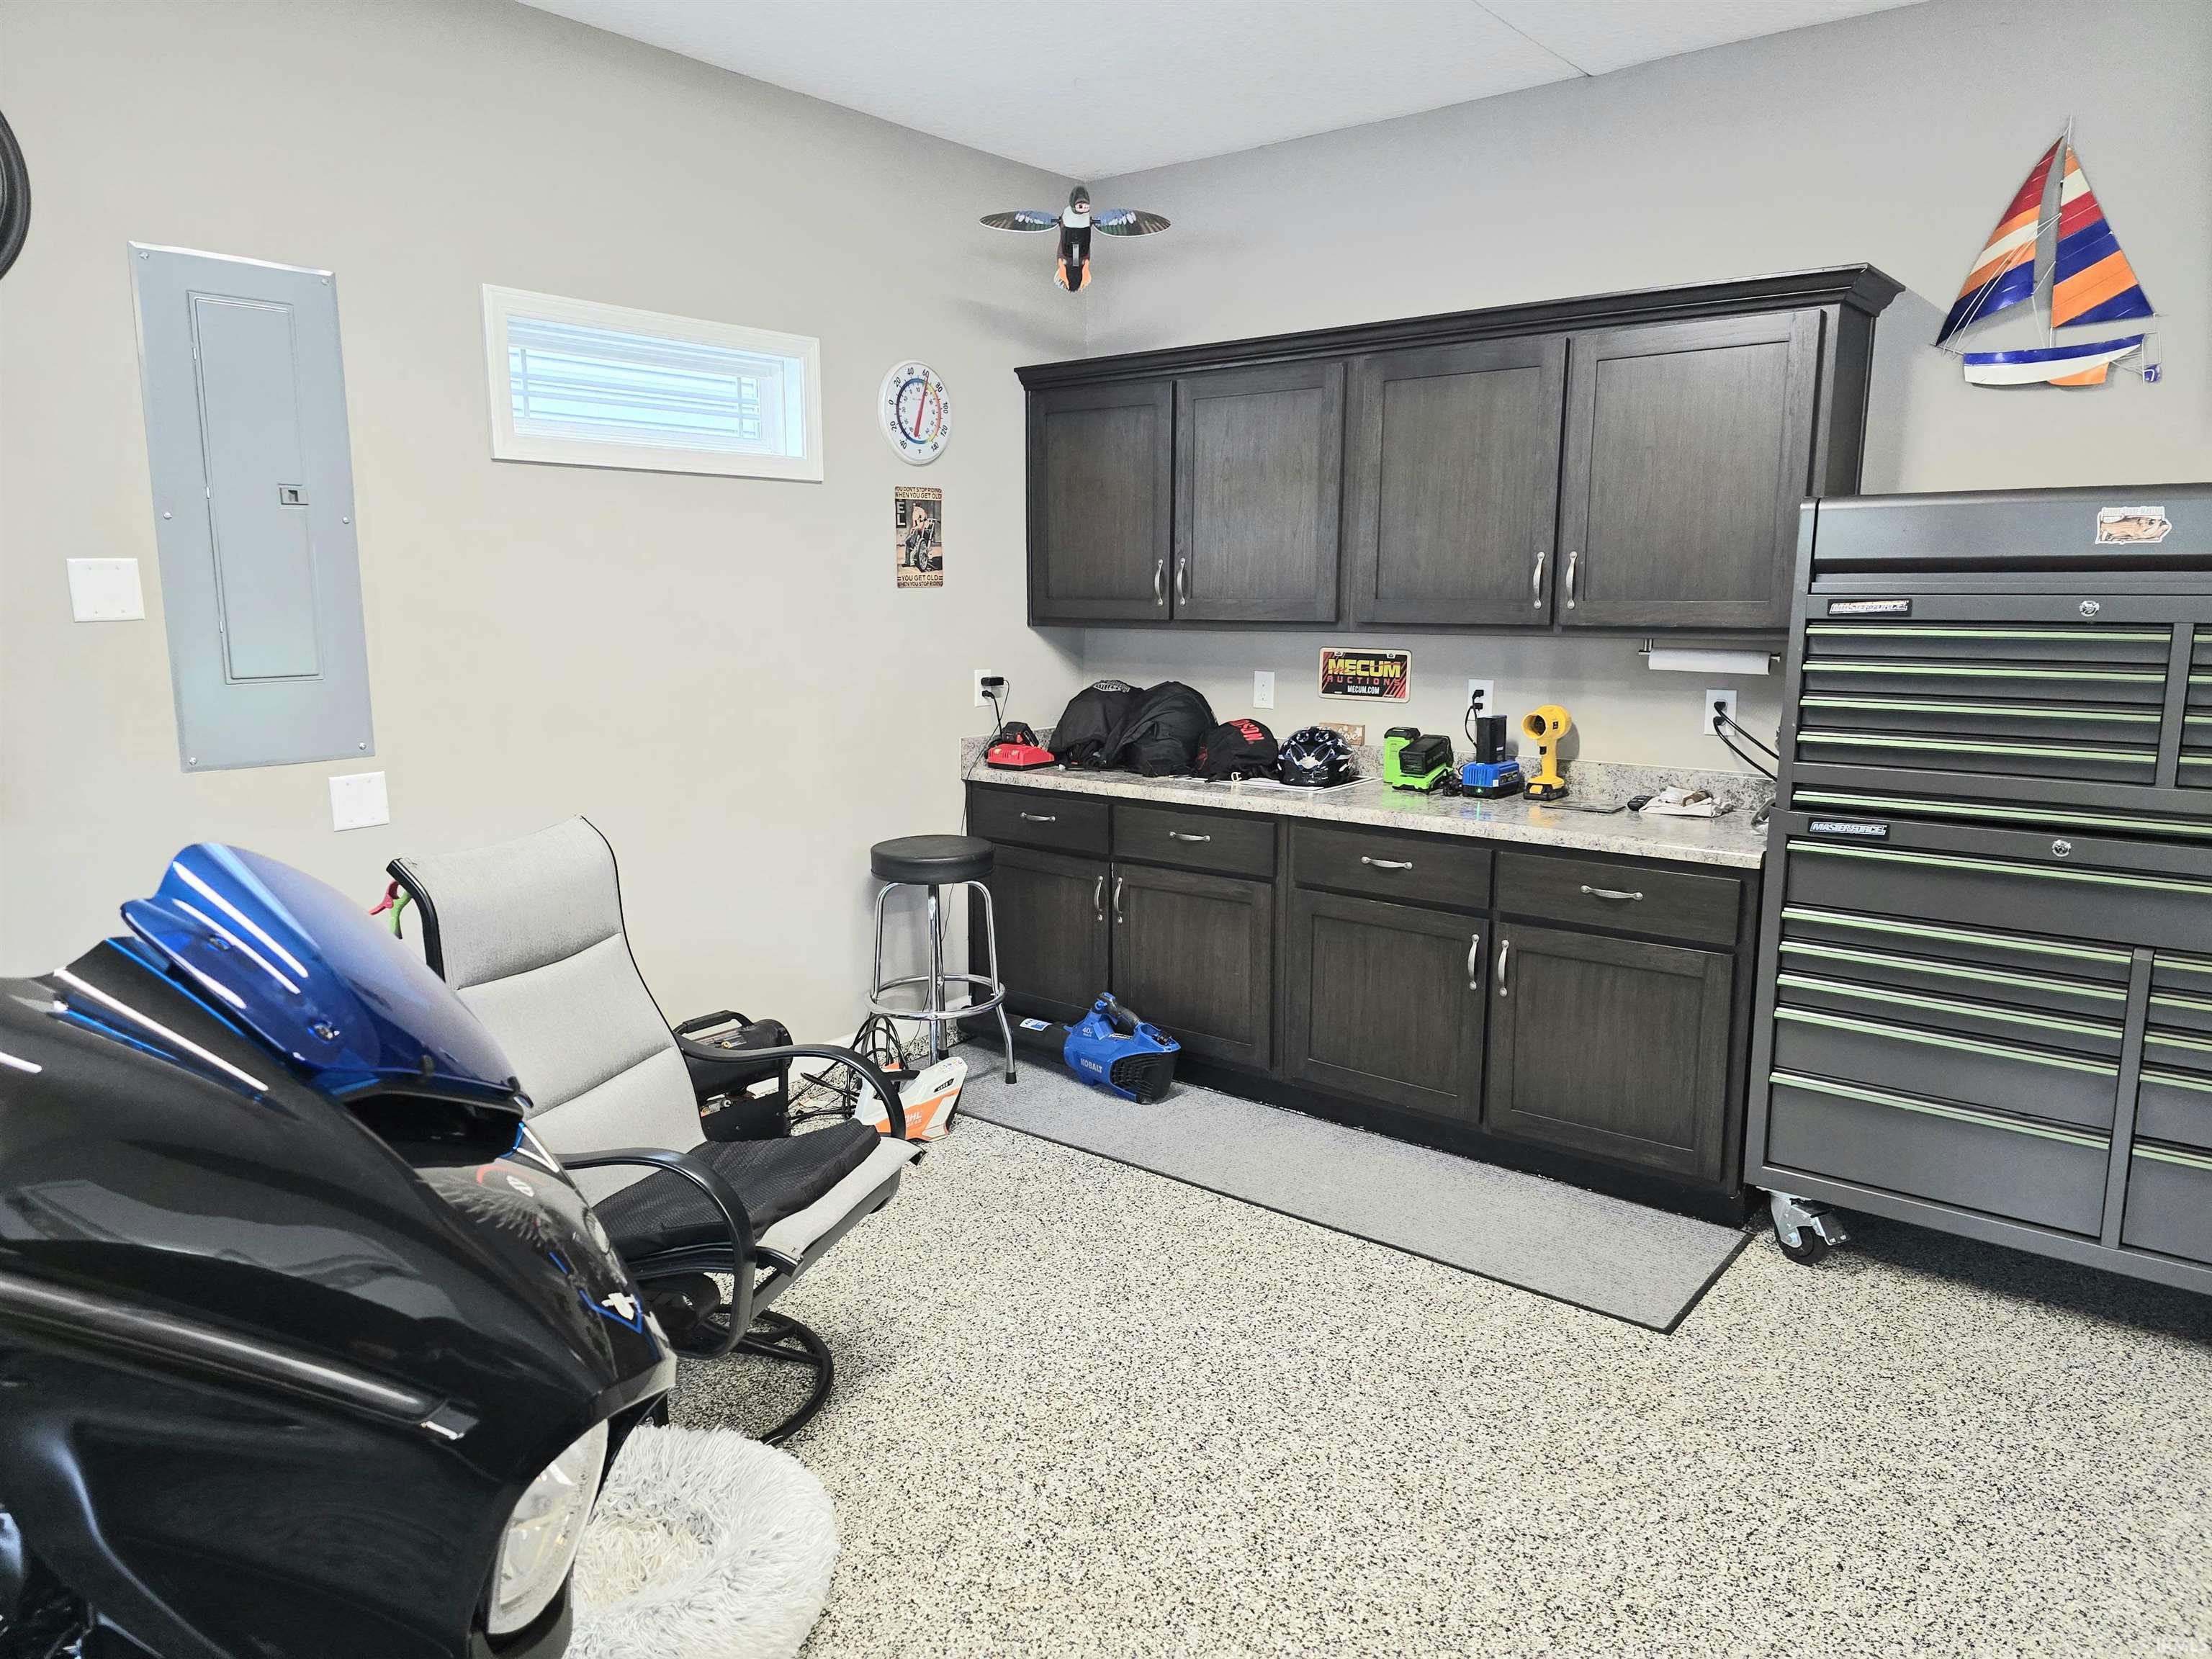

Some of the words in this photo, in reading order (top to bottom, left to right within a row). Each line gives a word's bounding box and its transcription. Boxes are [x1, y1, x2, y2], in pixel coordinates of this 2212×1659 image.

[922, 369, 929, 379] 60
[894, 377, 902, 387] 20
[935, 382, 943, 392] 80
[1328, 658, 1401, 678] MECUM
[1326, 675, 1401, 686] AUCTIONS
[1347, 685, 1380, 694] MECUM.COM
[1080, 1058, 1103, 1074] KOBALT
